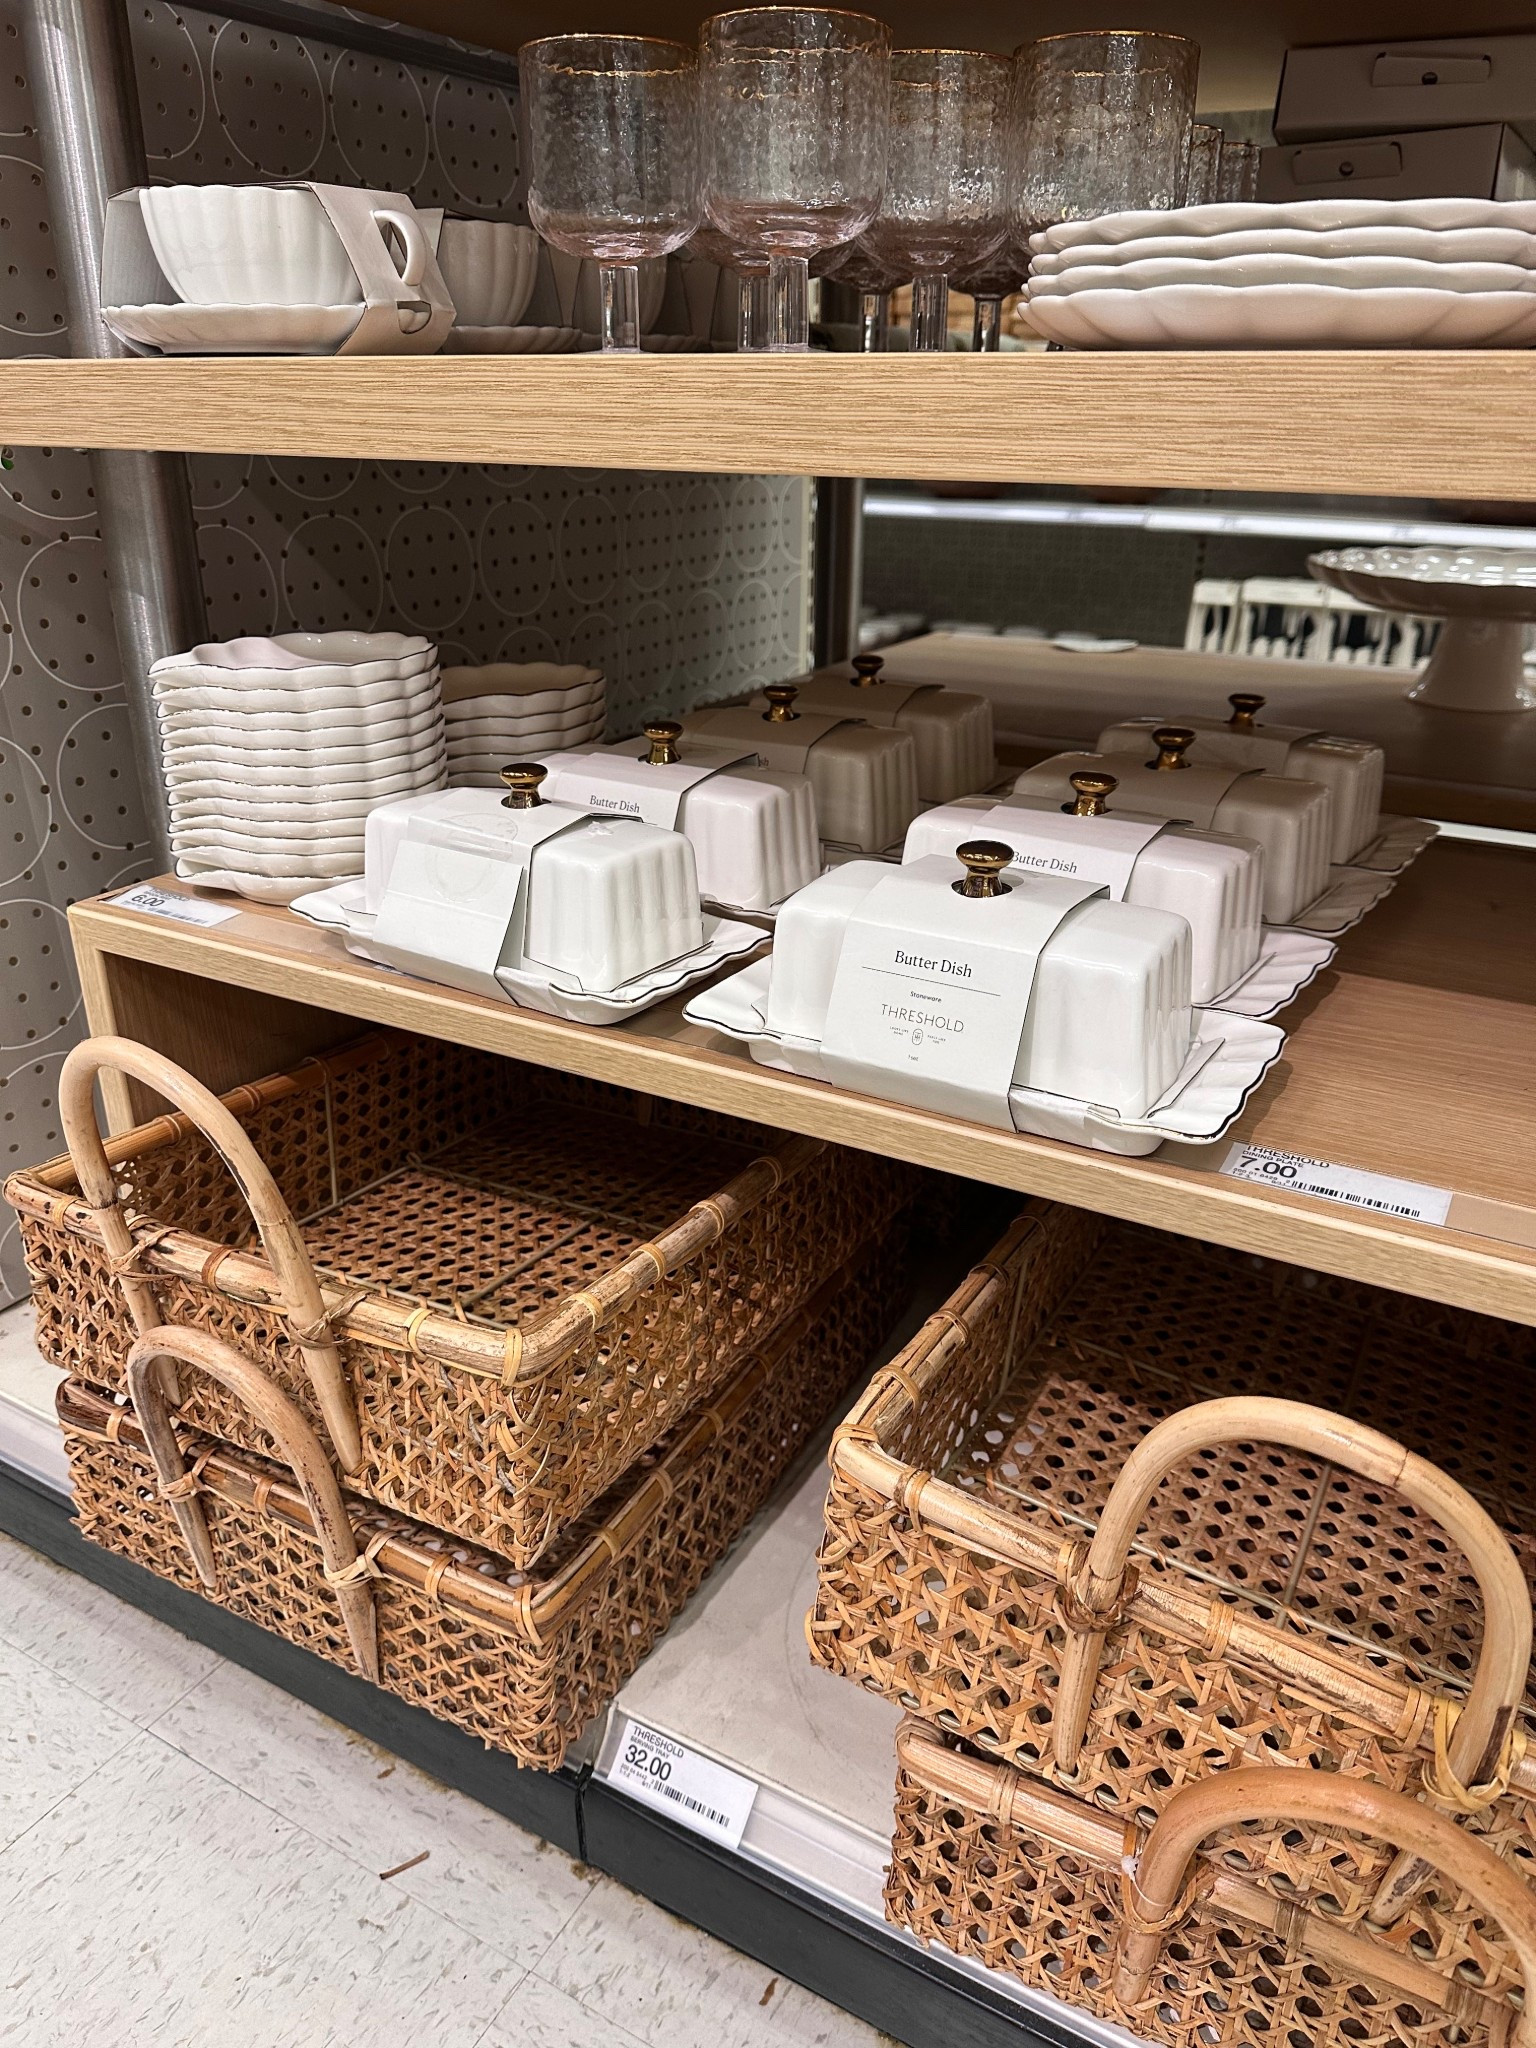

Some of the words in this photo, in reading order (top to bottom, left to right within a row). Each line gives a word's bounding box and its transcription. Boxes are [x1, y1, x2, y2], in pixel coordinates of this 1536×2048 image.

[589, 795, 618, 809] Butter
[619, 800, 640, 814] Dish
[1049, 858, 1078, 874] Dish
[131, 894, 165, 907] 6.00
[894, 950, 938, 971] Butter
[940, 959, 973, 978] Dish
[910, 990, 942, 1003] Stoneware
[881, 1003, 965, 1034] THRESHOLD
[1239, 1155, 1298, 1179] 7.00
[1242, 1150, 1274, 1162] DINING
[1276, 1158, 1305, 1168] PLATE
[1246, 1145, 1330, 1169] THRESHOLD
[630, 1735, 655, 1752] SERVING
[655, 1747, 670, 1759] TRAY
[633, 1725, 684, 1759] THRESHOLD
[625, 1744, 672, 1782] 32.00
